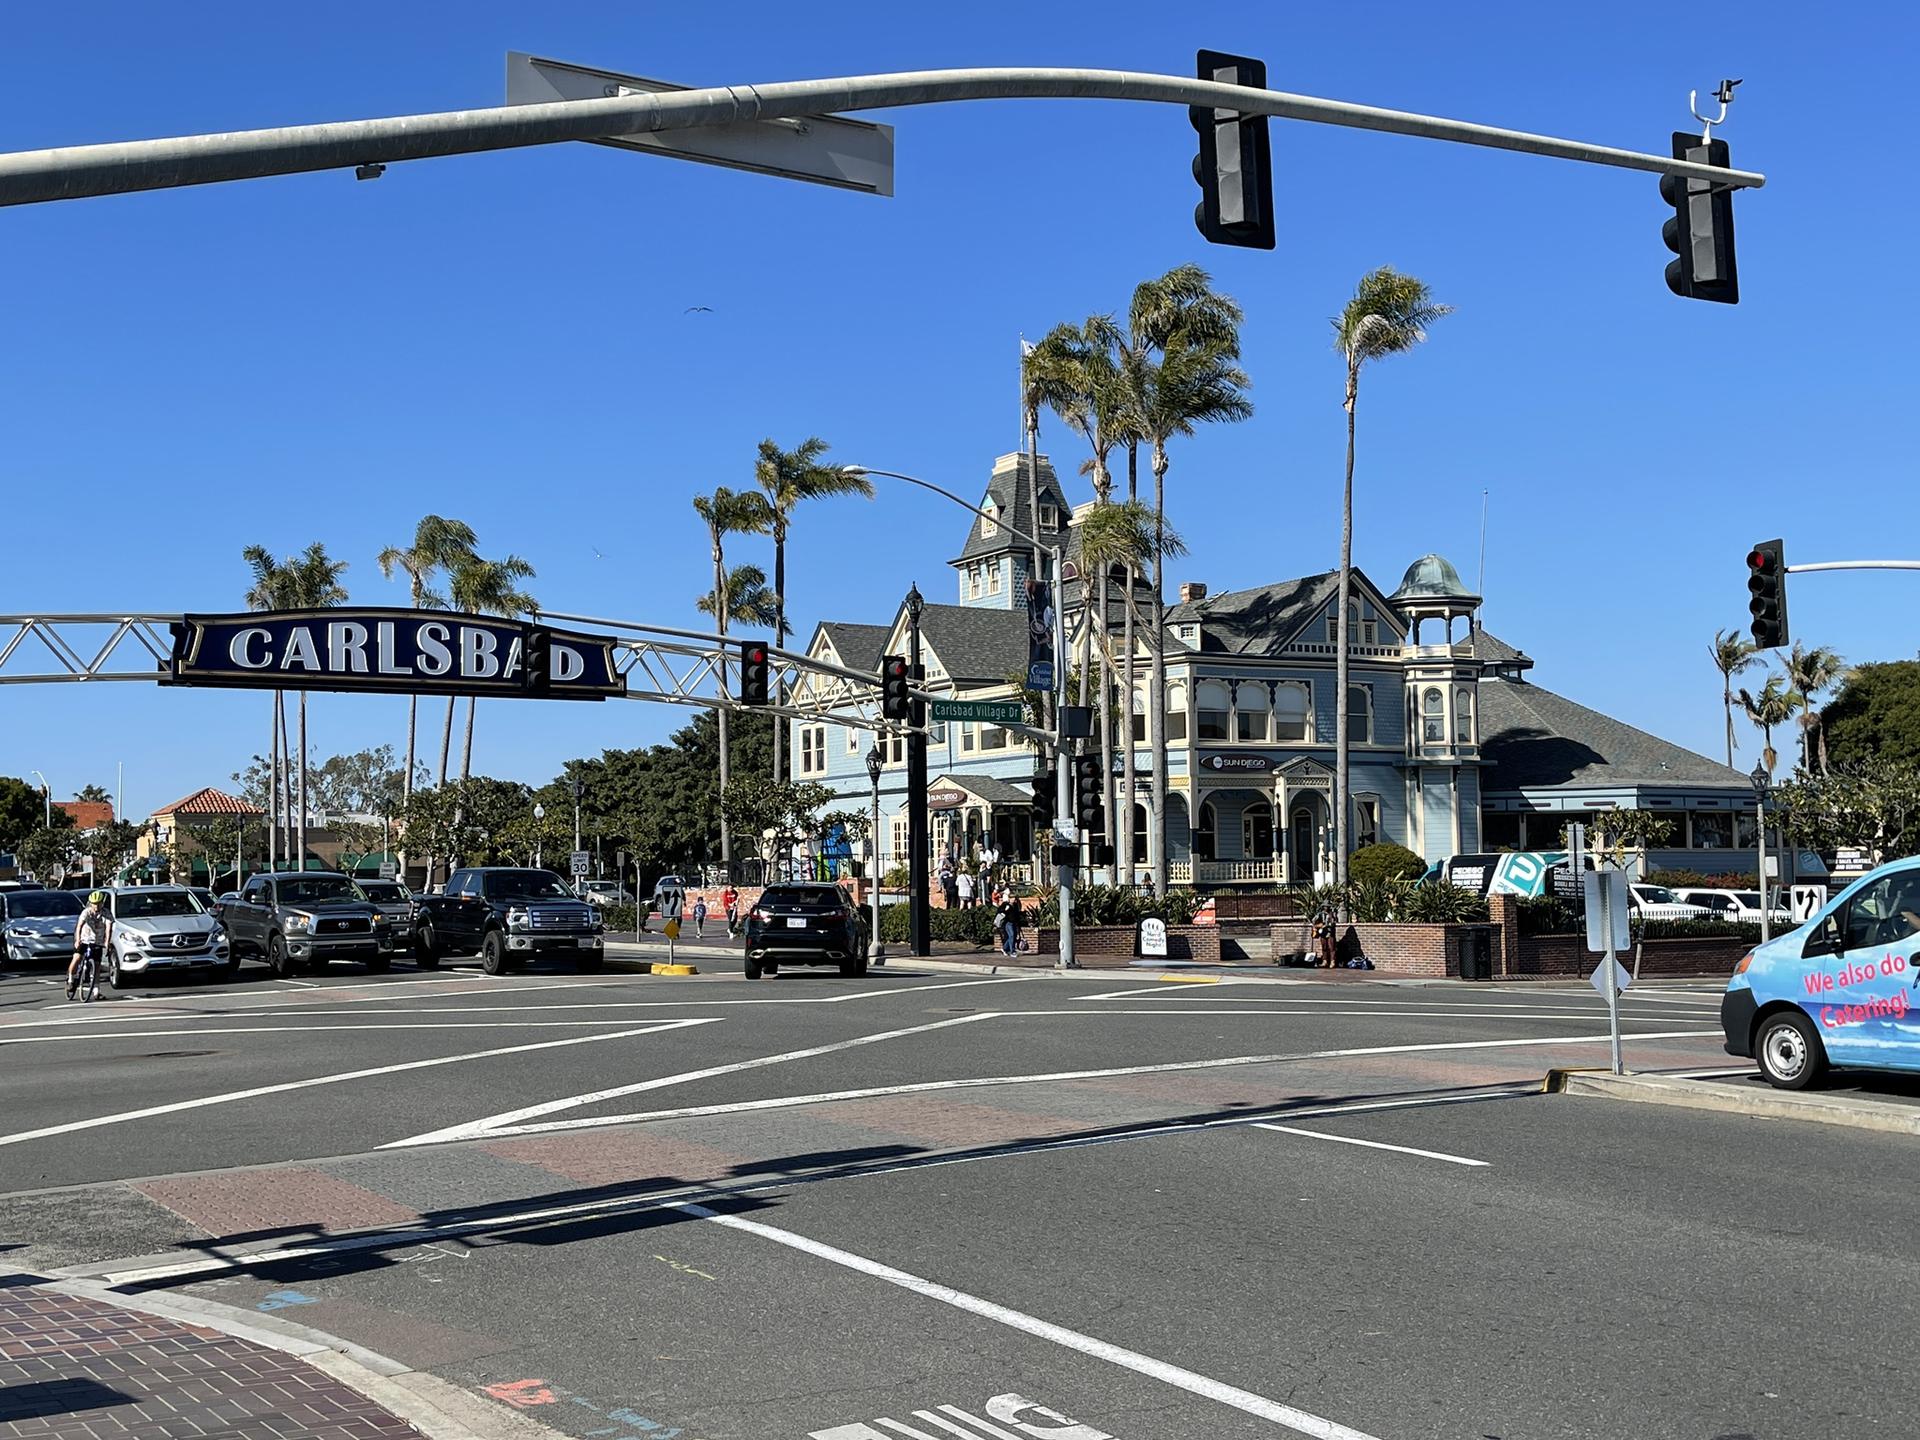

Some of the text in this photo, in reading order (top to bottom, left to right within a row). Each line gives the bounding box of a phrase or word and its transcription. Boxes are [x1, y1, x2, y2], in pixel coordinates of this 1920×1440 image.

[1029, 674, 1052, 687] Village
[935, 704, 1018, 720] Carlsbad Village Dr
[1241, 759, 1266, 767] DIEGO
[930, 793, 958, 802] SUN DIEGO
[573, 863, 588, 873] 30
[1143, 936, 1165, 944] Comedy
[1804, 953, 1906, 995] We also do
[1820, 988, 1910, 1028] Catering!
